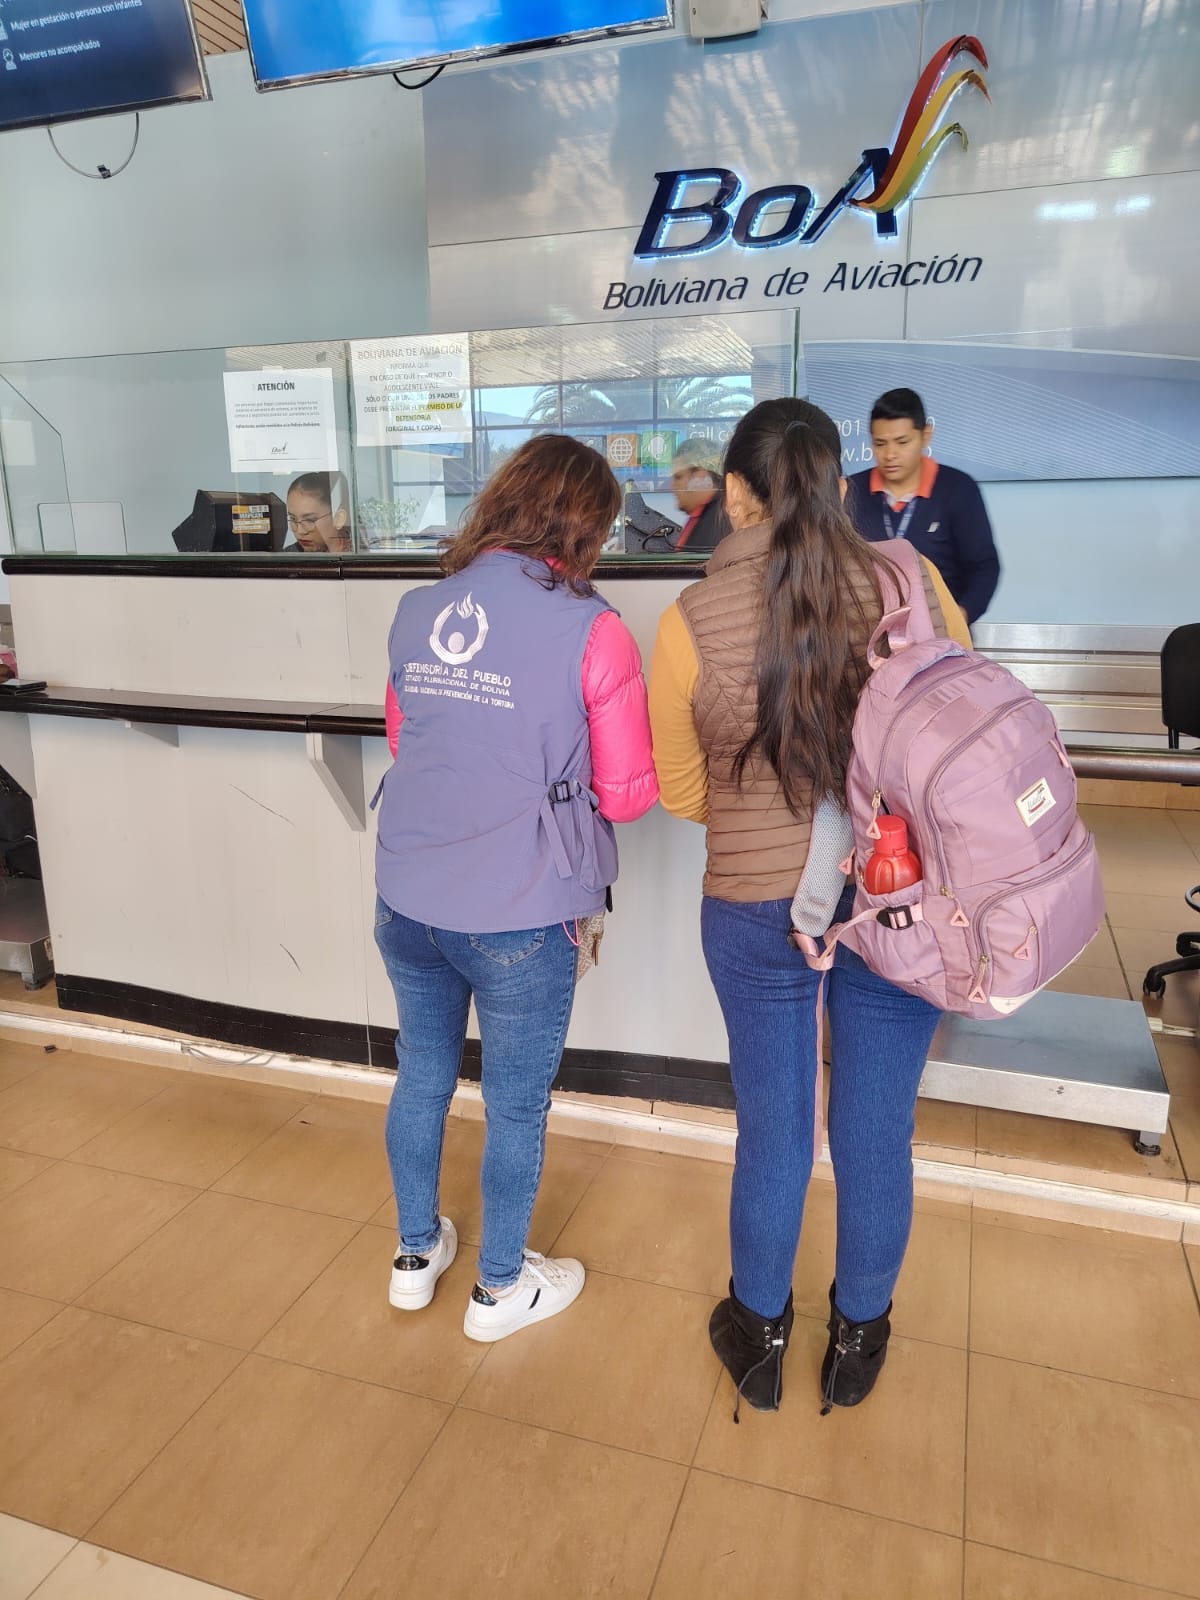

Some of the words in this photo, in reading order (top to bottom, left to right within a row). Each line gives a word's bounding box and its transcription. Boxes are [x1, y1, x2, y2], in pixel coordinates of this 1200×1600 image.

[10, 20, 30, 31] Mujer
[30, 18, 40, 27] en
[39, 12, 70, 28] gestación
[75, 7, 102, 20] persona
[102, 4, 115, 13] con
[19, 50, 48, 62] Menores
[47, 49, 57, 57] no
[57, 40, 101, 54] acompañados
[602, 273, 748, 311] Boliviana
[764, 266, 809, 298] de
[823, 253, 983, 293] Aviación
[358, 348, 404, 360] BOLIVIANA
[406, 348, 418, 356] DE
[419, 344, 463, 356] AVIACIÓN
[257, 380, 295, 391] ATENCIÓN
[403, 662, 449, 676] DEFENSORÍA
[452, 667, 469, 679] DEL
[473, 670, 511, 687] PUEBLO
[423, 675, 467, 688] PLURINACIONAL
[470, 682, 480, 690] DE
[481, 684, 511, 696] BOLIVIA
[473, 694, 481, 702] DE
[481, 696, 489, 704] LA
[491, 697, 516, 710] TORTURA
